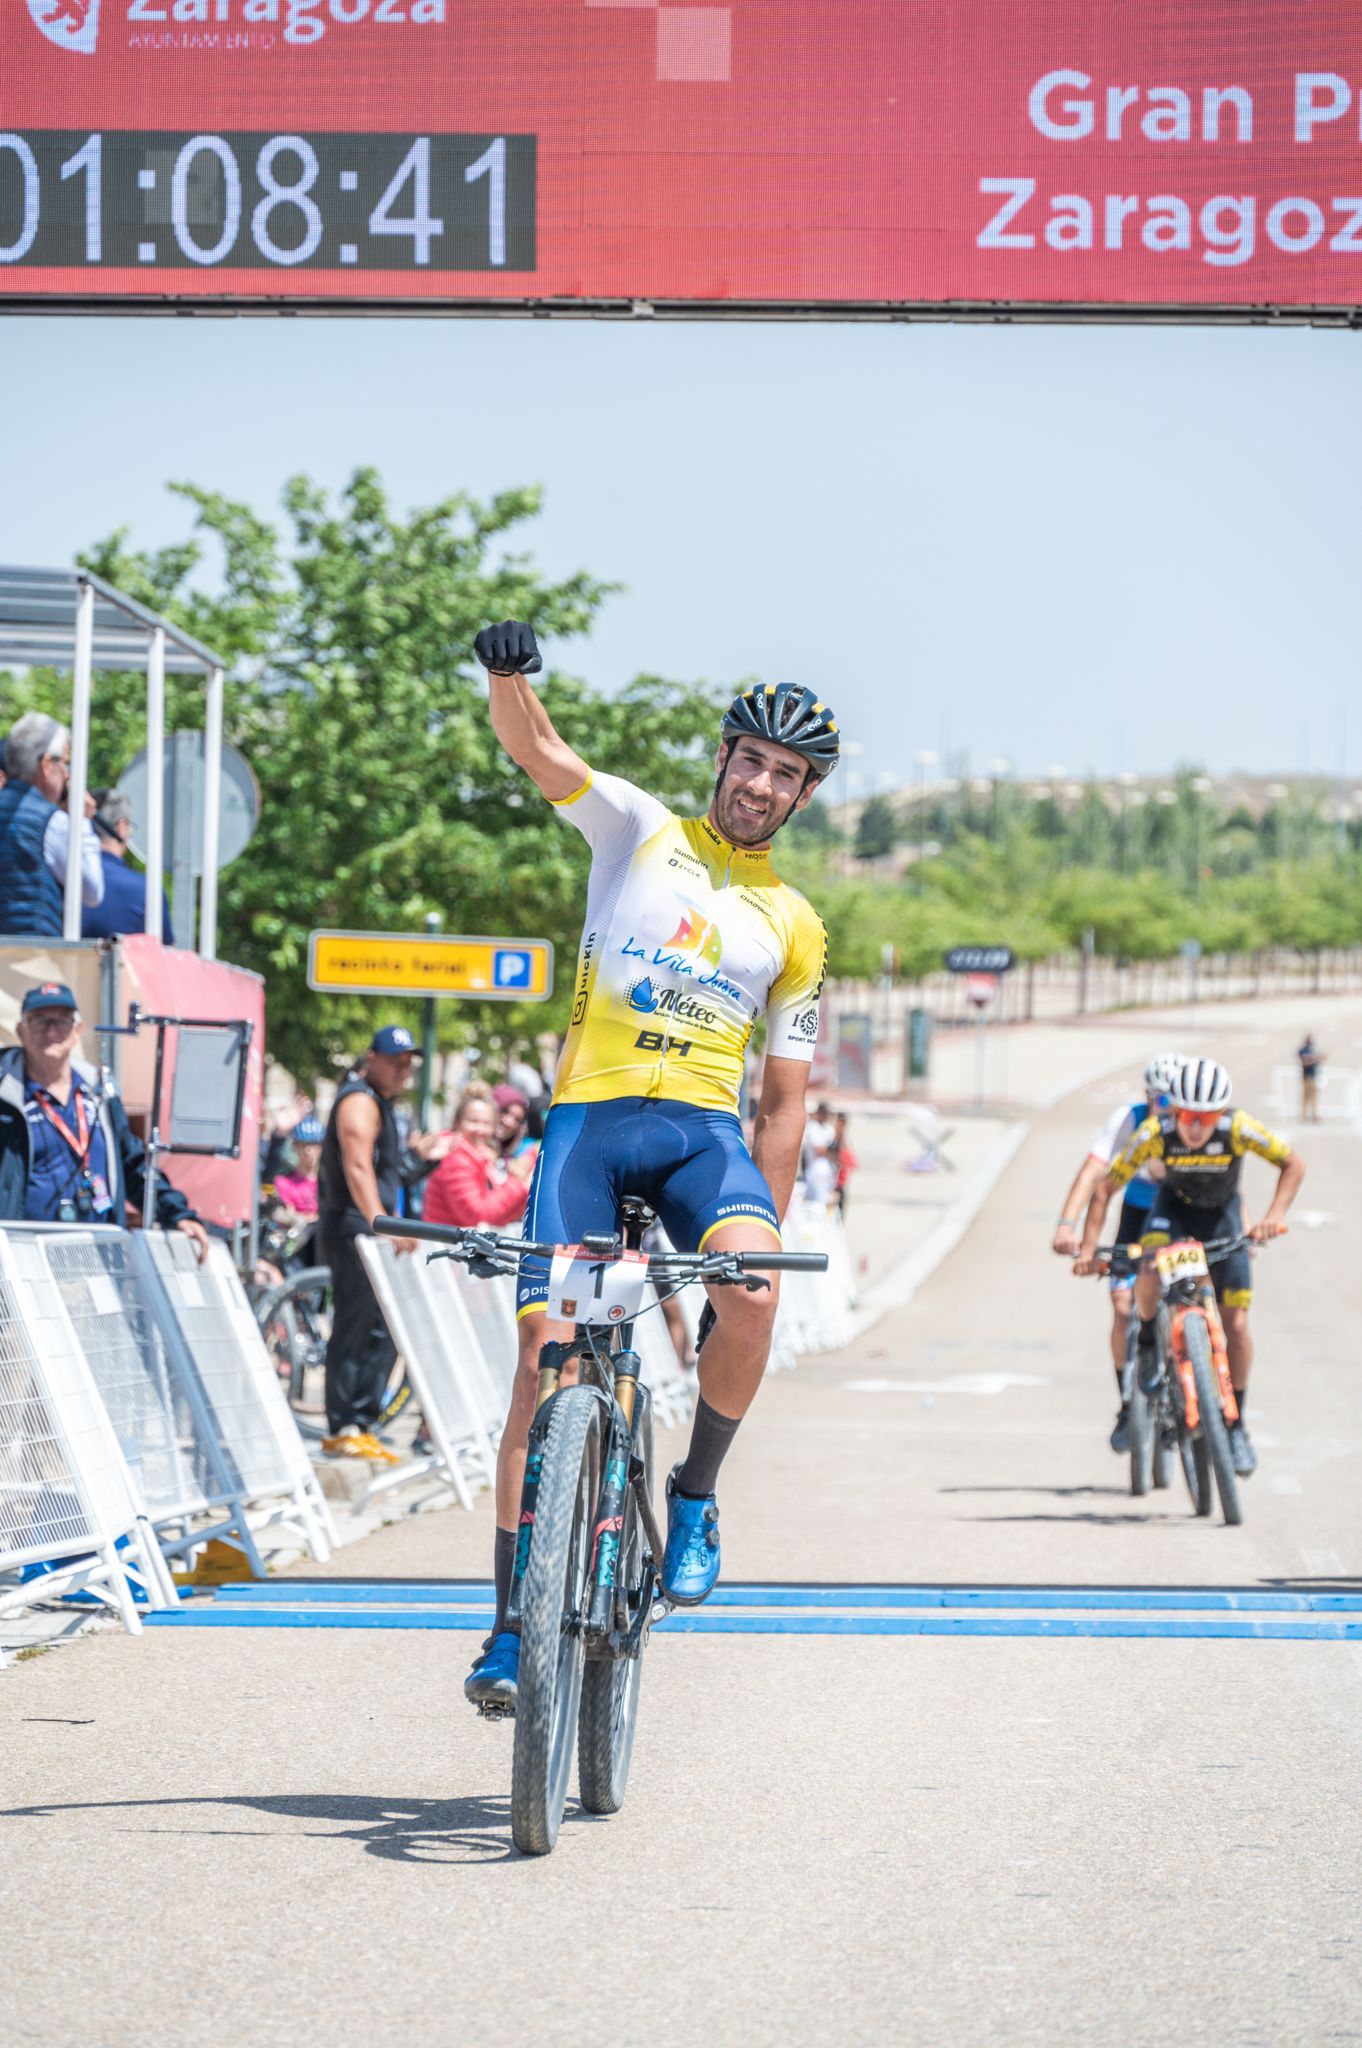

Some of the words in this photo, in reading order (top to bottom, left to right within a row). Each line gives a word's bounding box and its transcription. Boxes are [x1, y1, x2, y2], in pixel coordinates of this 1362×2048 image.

[1027, 68, 1254, 143] Gran
[1294, 72, 1362, 143] P
[0, 134, 506, 266] 01:08:41
[622, 936, 646, 960] La
[653, 948, 693, 976] Vila
[634, 1030, 693, 1057] BH
[716, 1203, 778, 1226] SHIMANO
[588, 1262, 607, 1299] 1
